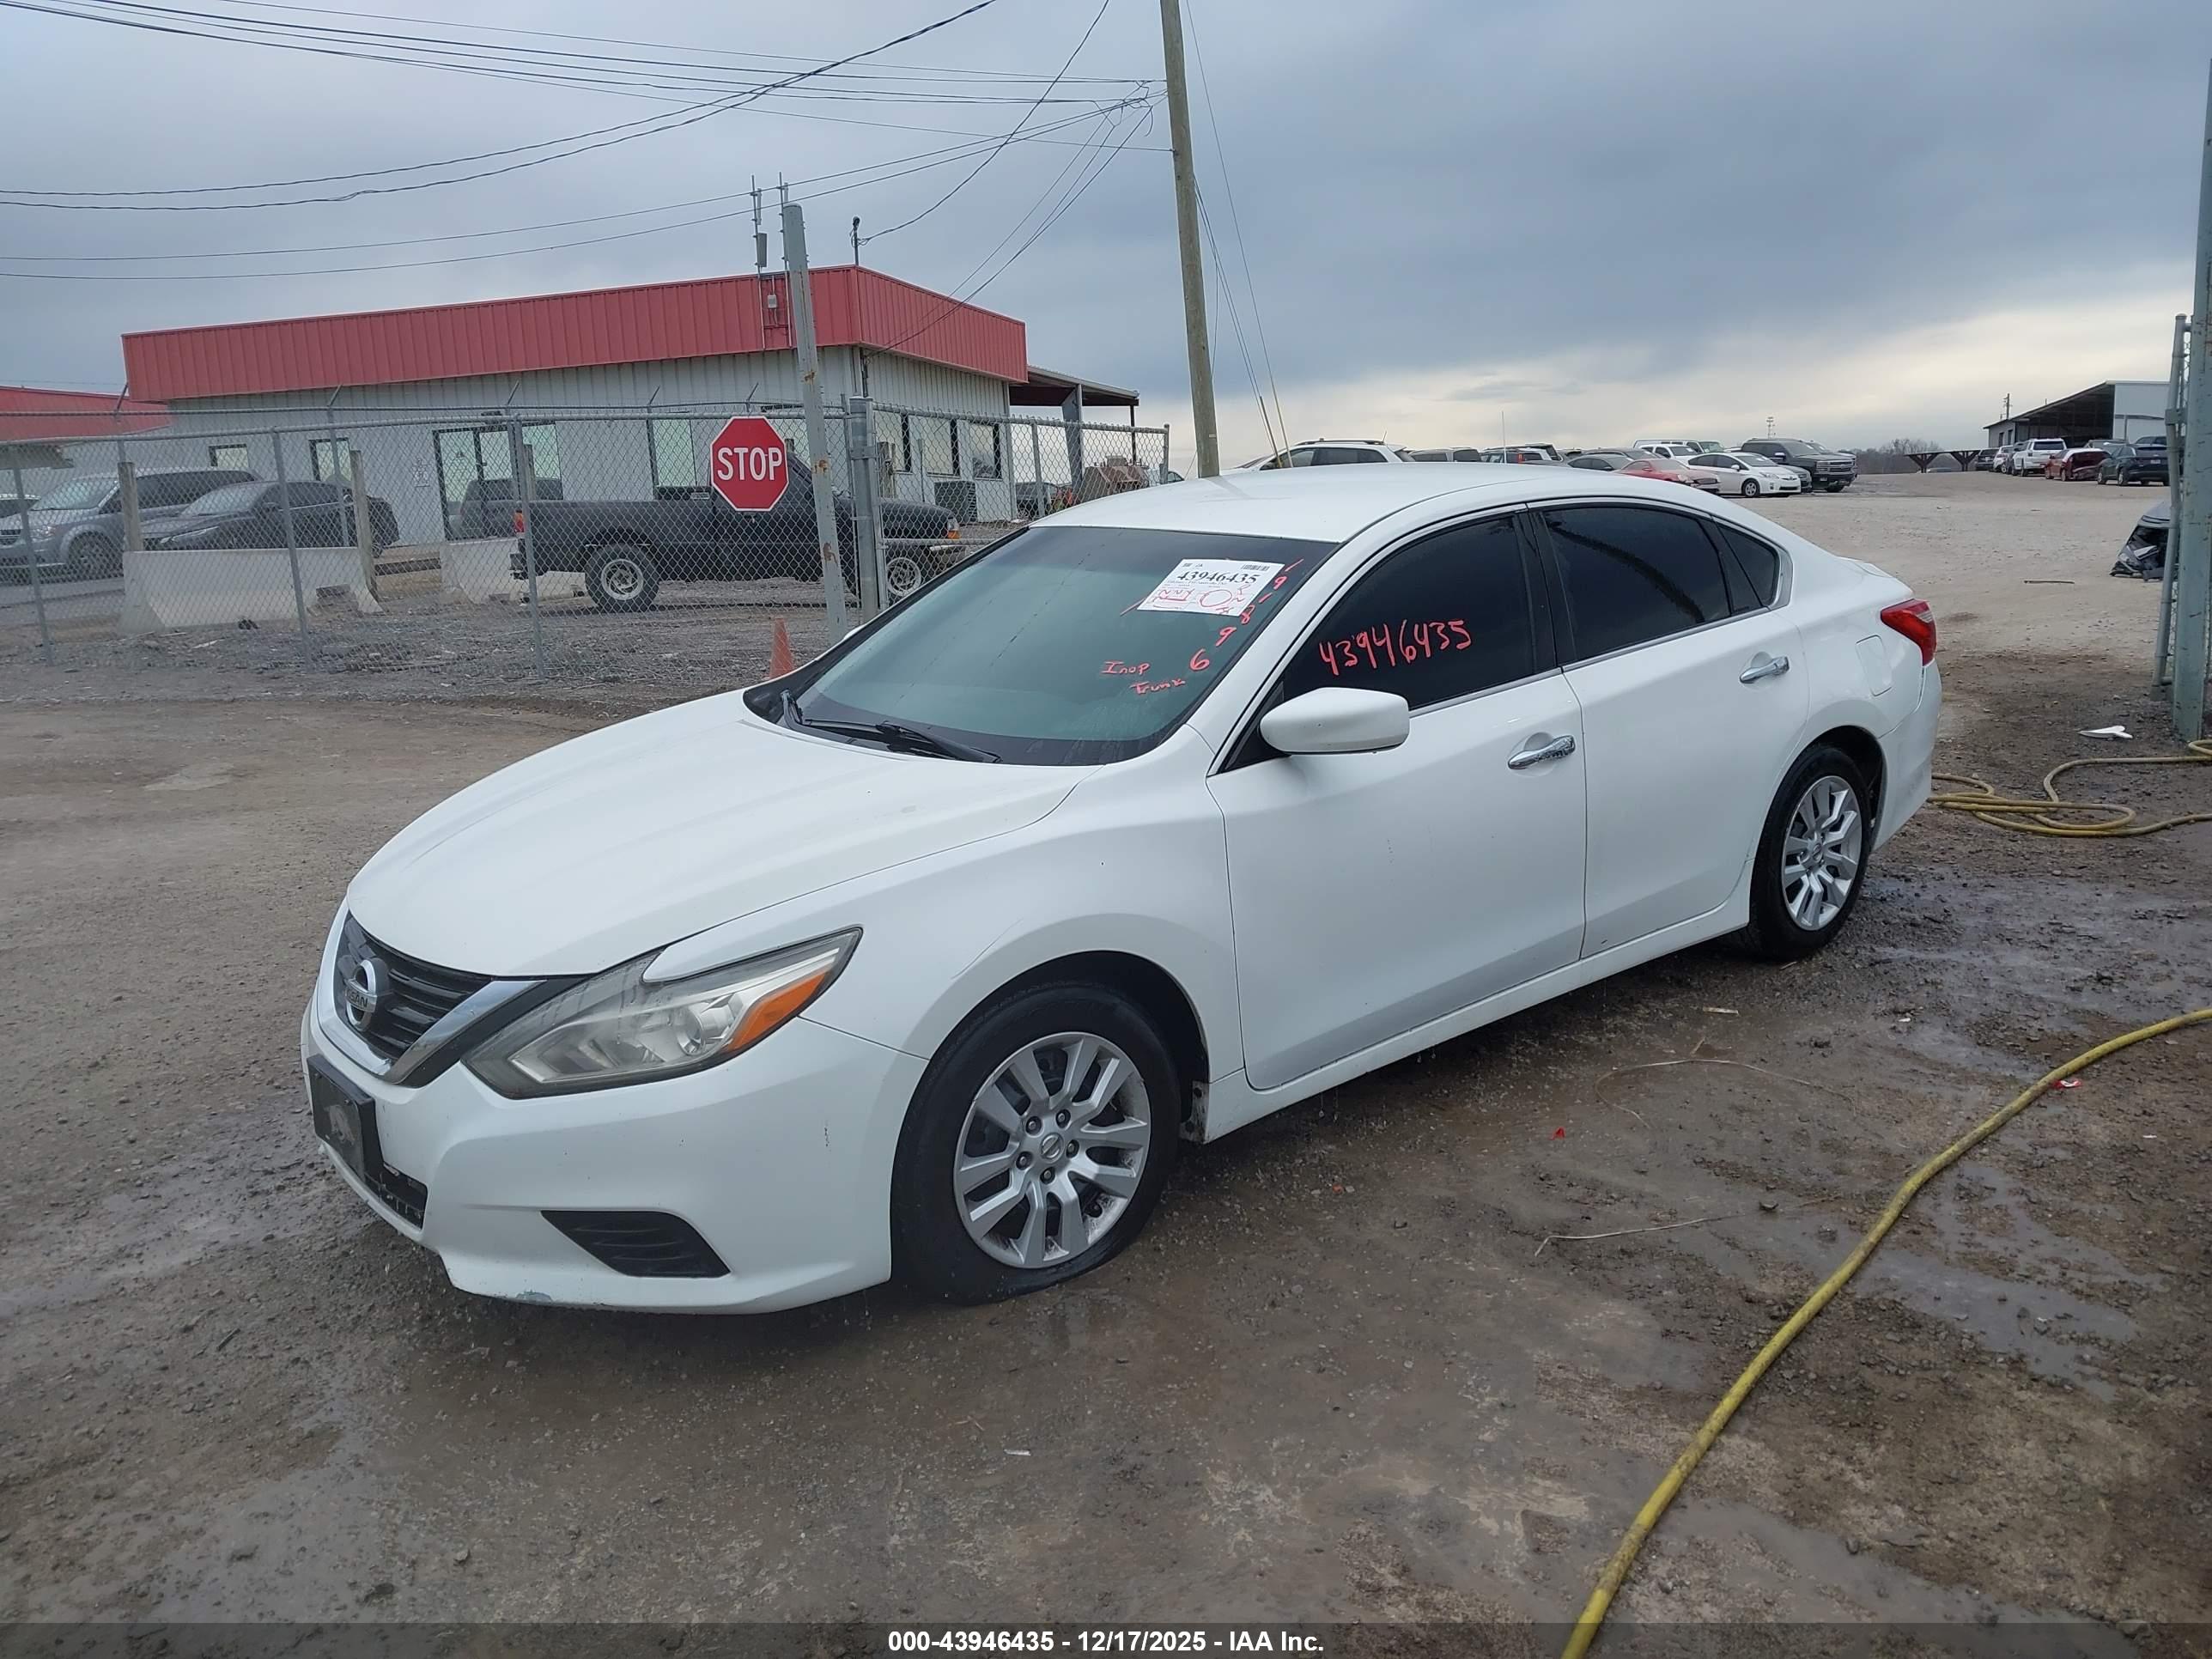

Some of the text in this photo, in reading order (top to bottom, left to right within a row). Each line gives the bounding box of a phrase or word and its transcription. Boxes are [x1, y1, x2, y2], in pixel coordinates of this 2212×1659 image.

[717, 447, 782, 481] STOP
[1176, 571, 1261, 584] 43946435
[1319, 619, 1472, 676] 43946435
